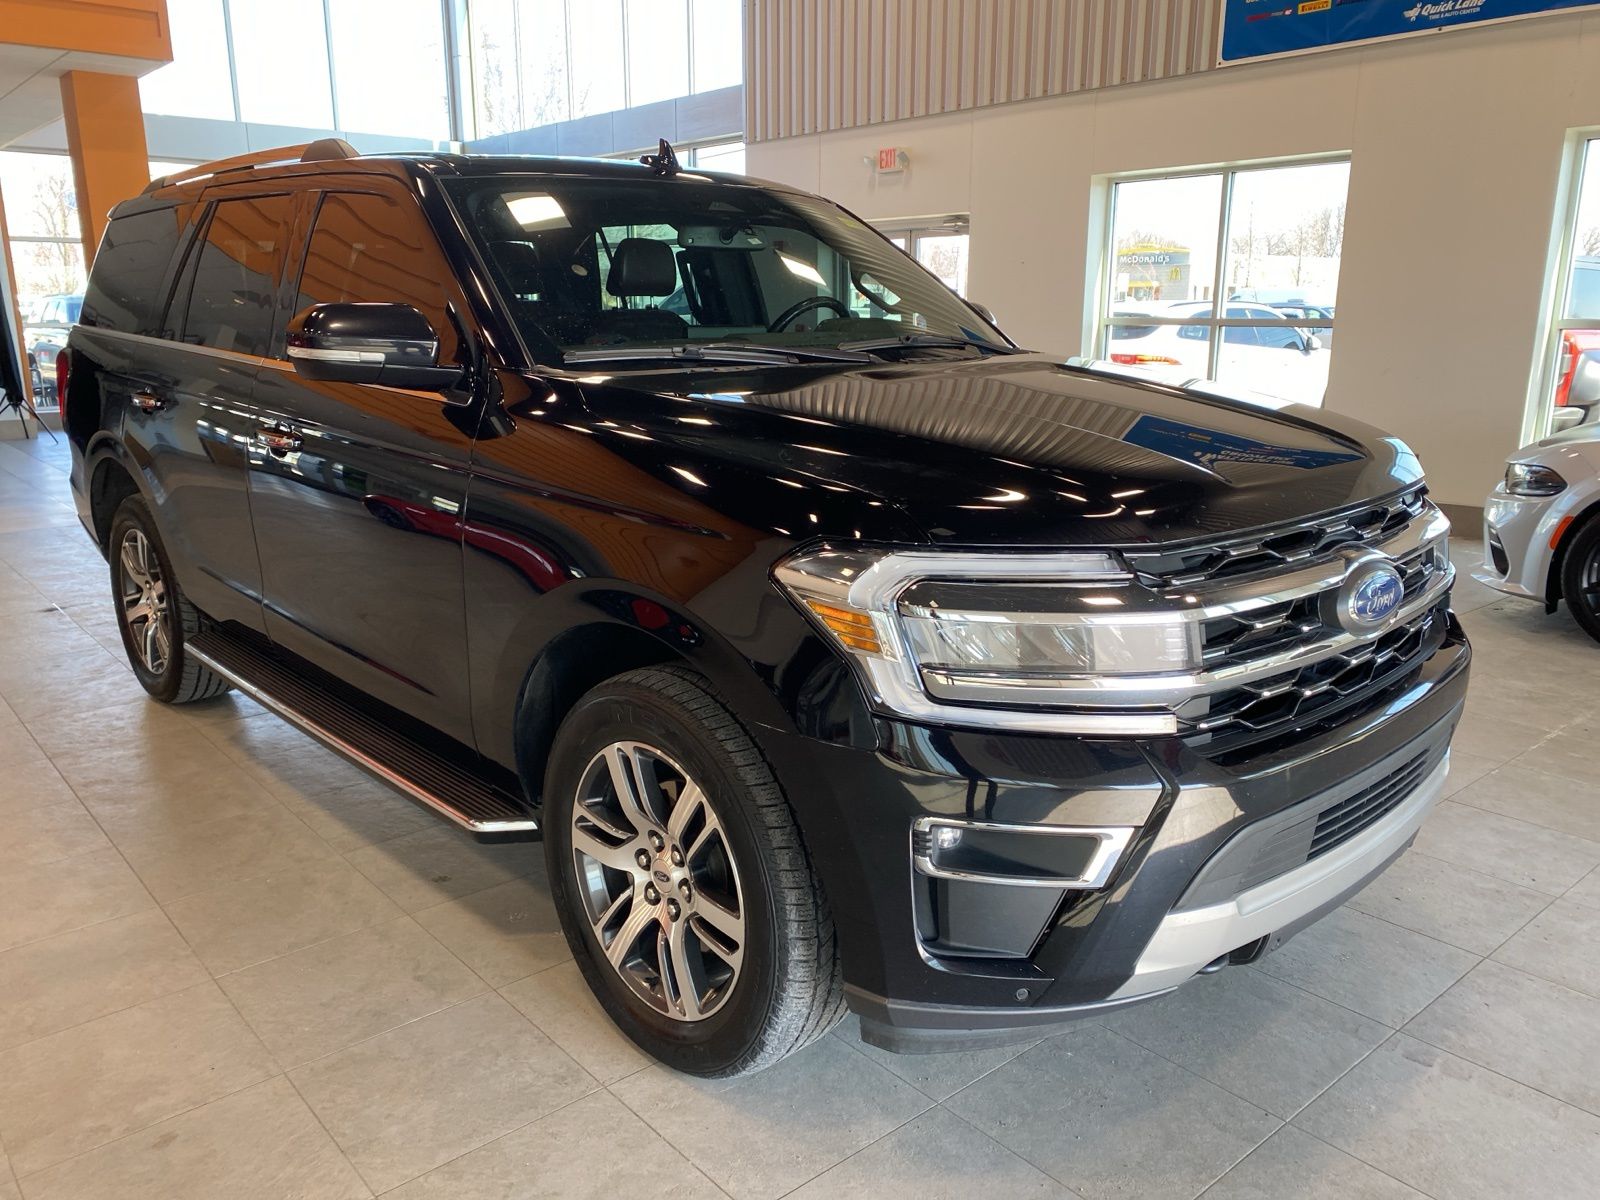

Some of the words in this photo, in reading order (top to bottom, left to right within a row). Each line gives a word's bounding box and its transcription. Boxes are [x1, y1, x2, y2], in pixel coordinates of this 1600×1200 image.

[1421, 0, 1455, 15] Quick
[1443, 10, 1459, 18] AUTO
[1459, 7, 1481, 16] CENTER
[879, 148, 896, 170] EXIT
[1366, 583, 1396, 615] Ford
